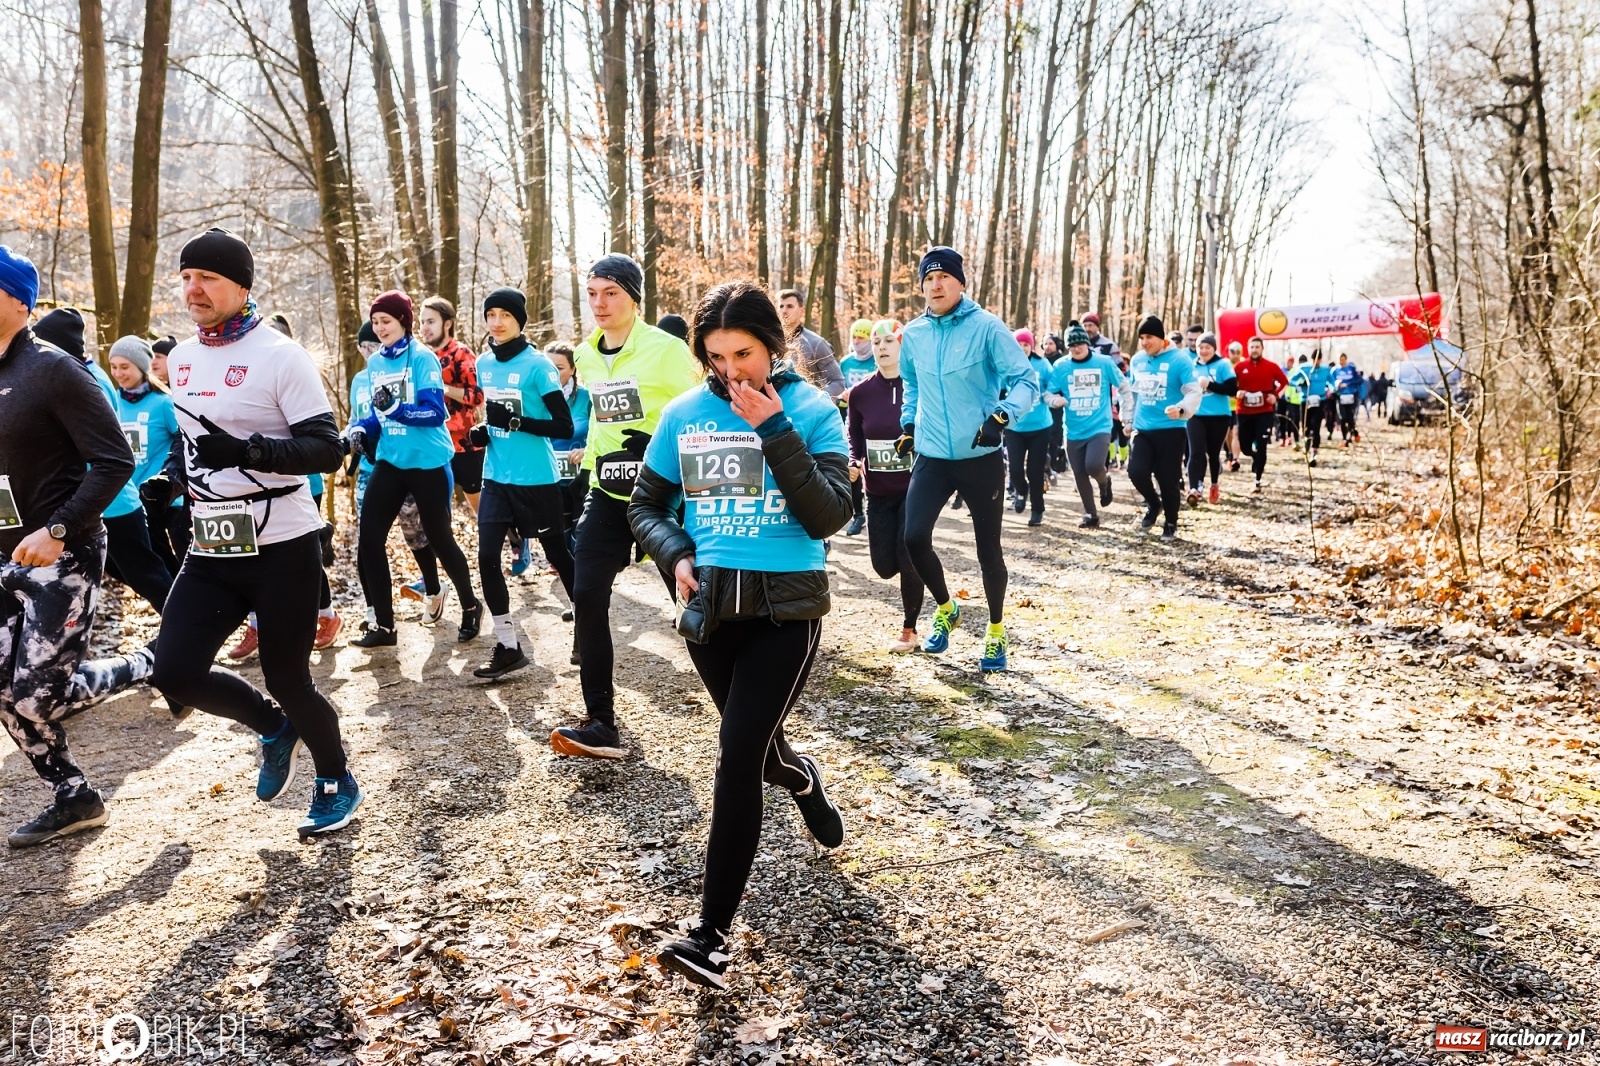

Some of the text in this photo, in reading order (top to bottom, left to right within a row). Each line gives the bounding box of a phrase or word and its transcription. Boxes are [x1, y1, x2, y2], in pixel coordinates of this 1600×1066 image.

[1294, 313, 1360, 325] TWARDZIELA
[599, 393, 630, 412] 025
[709, 435, 755, 443] Twardziela
[876, 450, 902, 463] 104
[604, 463, 638, 479] adid
[696, 454, 741, 480] 126
[696, 490, 787, 515] BIEG
[696, 515, 789, 527] TWARDZIELA
[201, 520, 236, 541] 120
[712, 525, 760, 538] 2022
